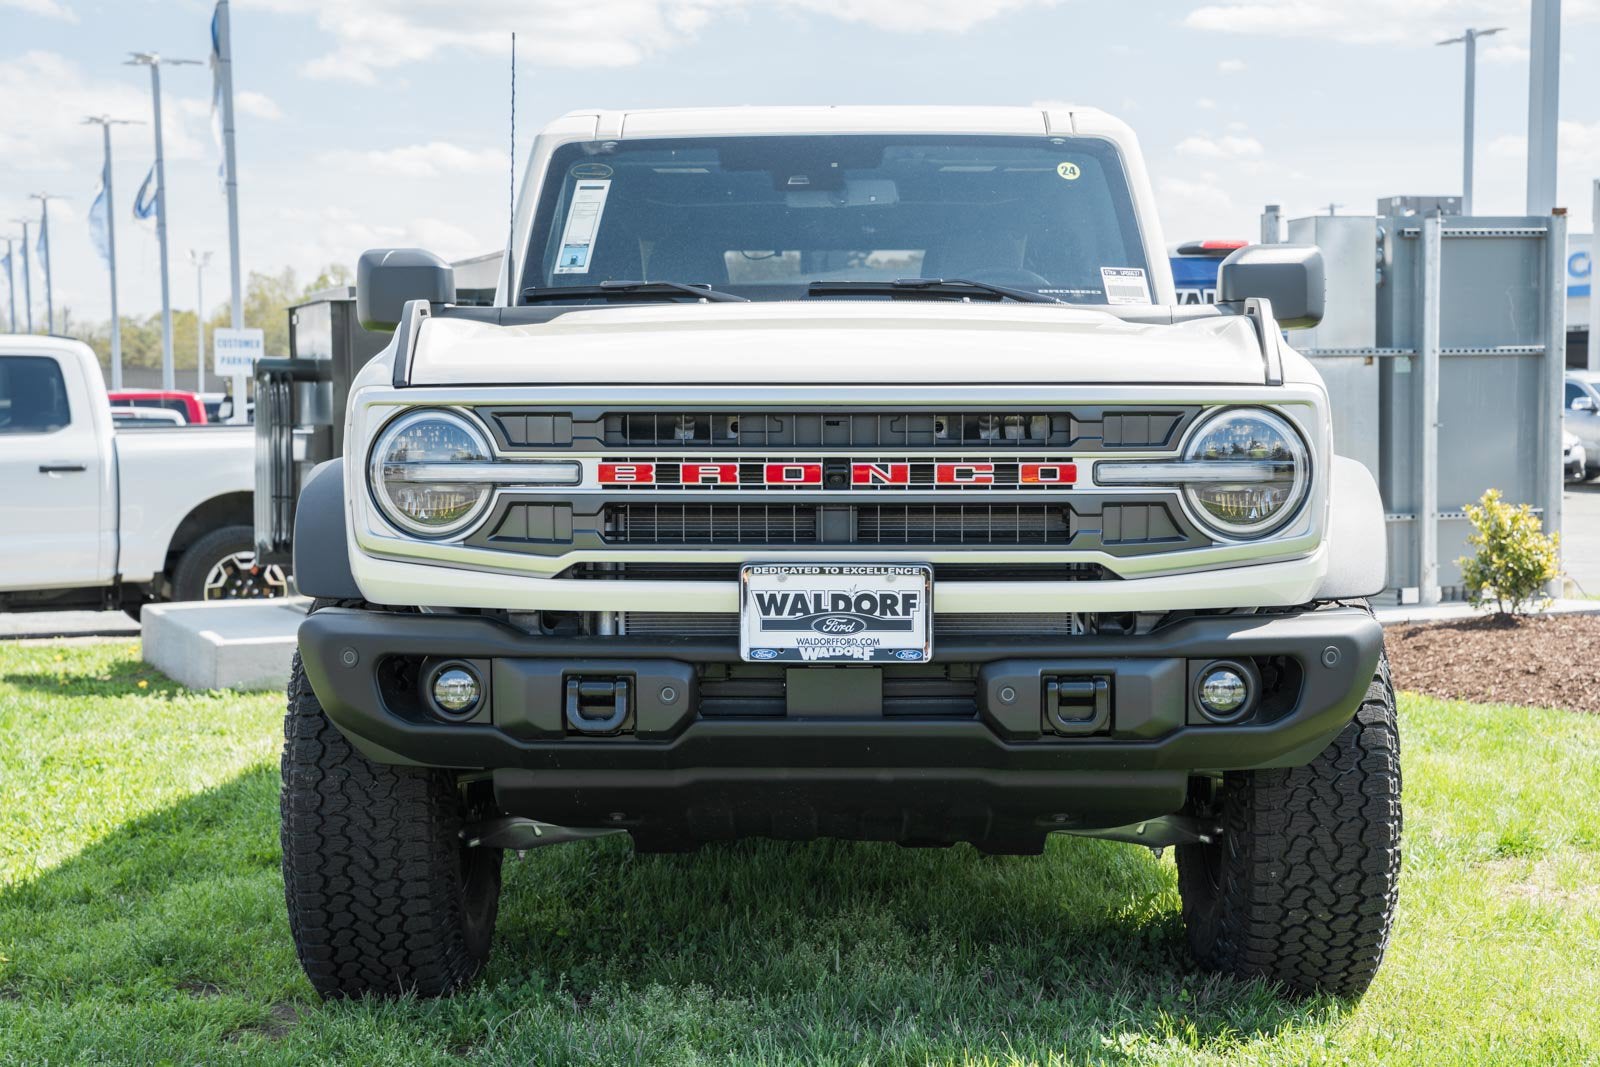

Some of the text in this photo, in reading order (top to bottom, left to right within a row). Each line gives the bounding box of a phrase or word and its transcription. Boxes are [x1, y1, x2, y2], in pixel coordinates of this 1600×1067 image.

[1061, 165, 1077, 176] 24
[217, 339, 260, 349] CUSTOMER
[221, 356, 252, 366] PARKIN
[597, 462, 1078, 486] BRONCO
[753, 567, 820, 575] DEDICATED
[842, 567, 920, 575] EXCELLENCE
[752, 591, 920, 618] WALDORF
[822, 618, 856, 632] Ford
[796, 637, 881, 646] WALDORFFORD.COM
[798, 646, 875, 661] WALDORF
